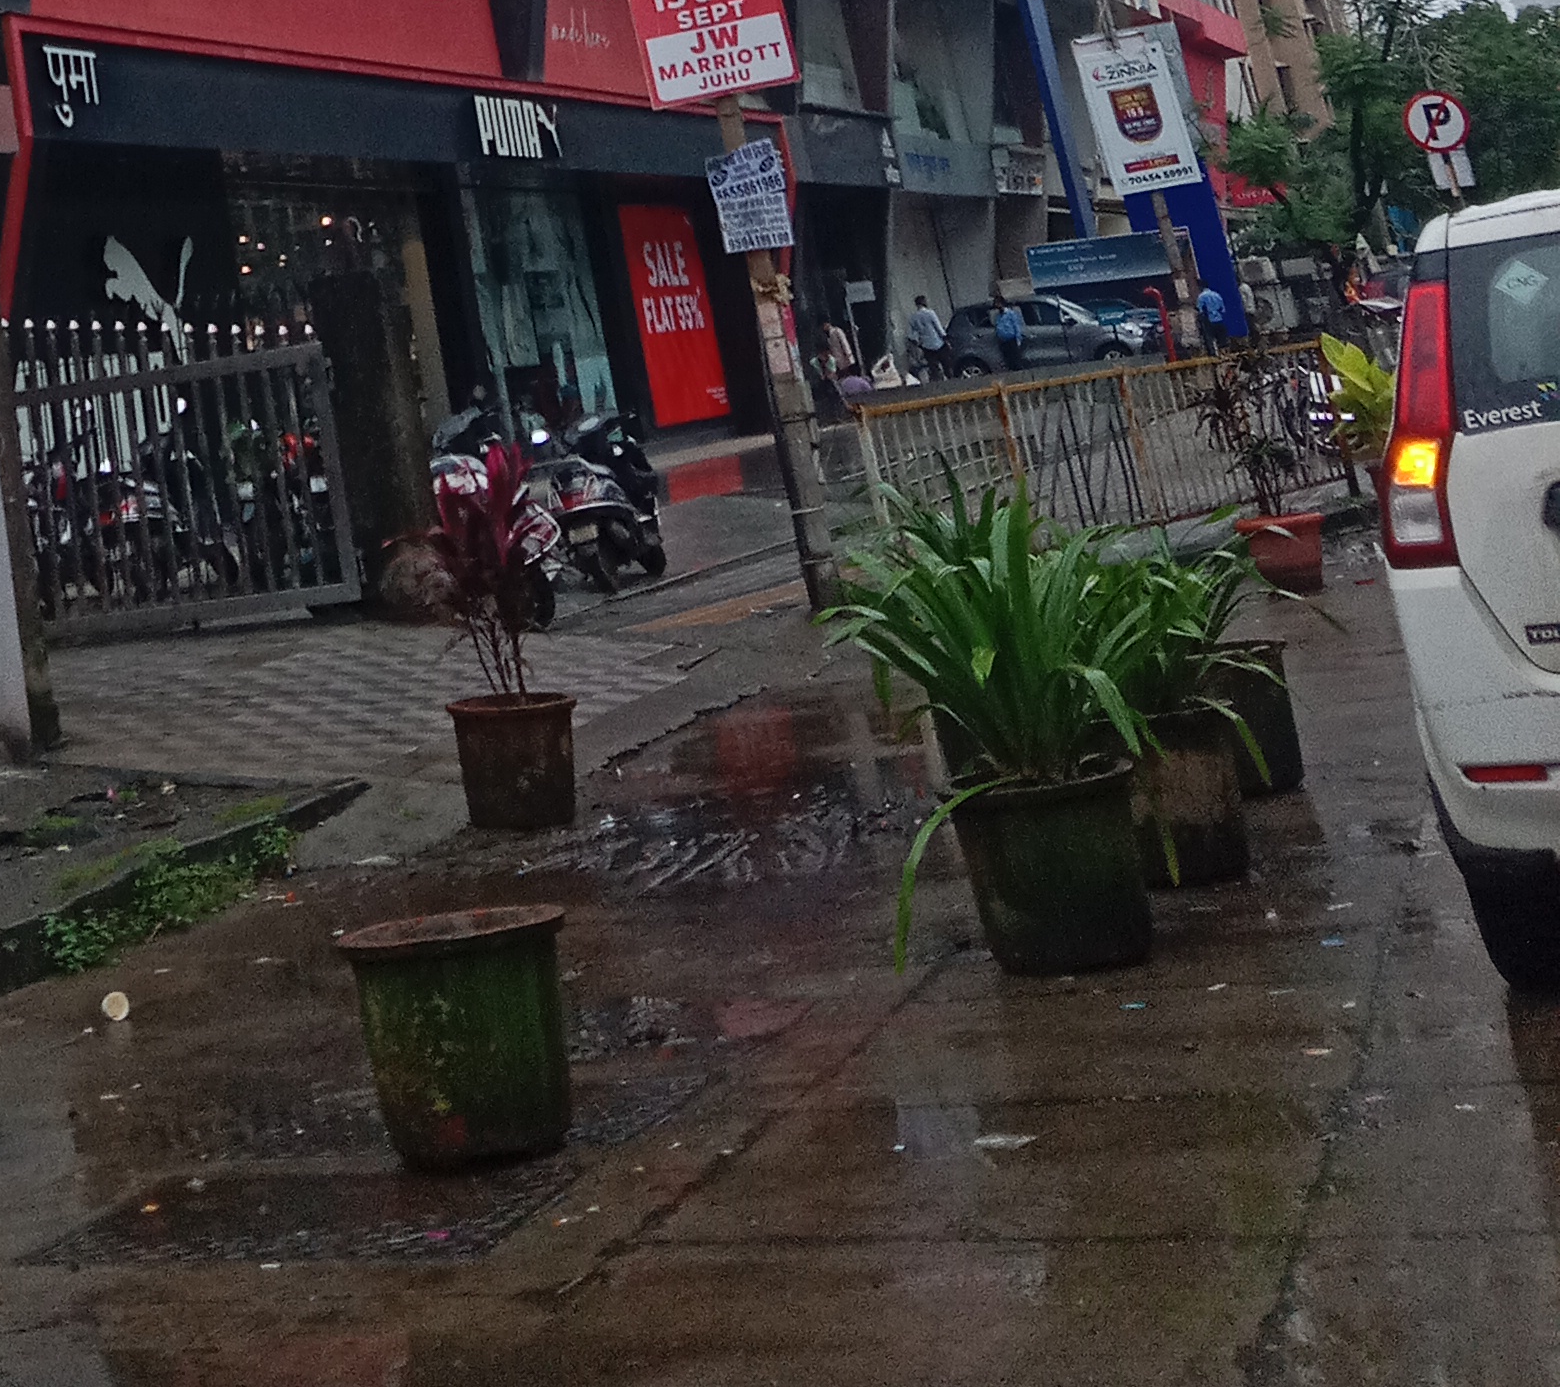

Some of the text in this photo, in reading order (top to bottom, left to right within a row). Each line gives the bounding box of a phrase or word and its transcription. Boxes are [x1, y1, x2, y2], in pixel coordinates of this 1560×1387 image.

[690, 24, 740, 55] JW
[658, 41, 782, 82] MARRIOTT
[698, 67, 751, 90] JUHU
[1107, 62, 1157, 80] ZINNIA
[42, 44, 100, 127] पुमा
[474, 94, 543, 159] PUMA
[643, 240, 690, 288] SALE
[642, 294, 677, 334] FLAT
[1463, 400, 1543, 429] Everest
